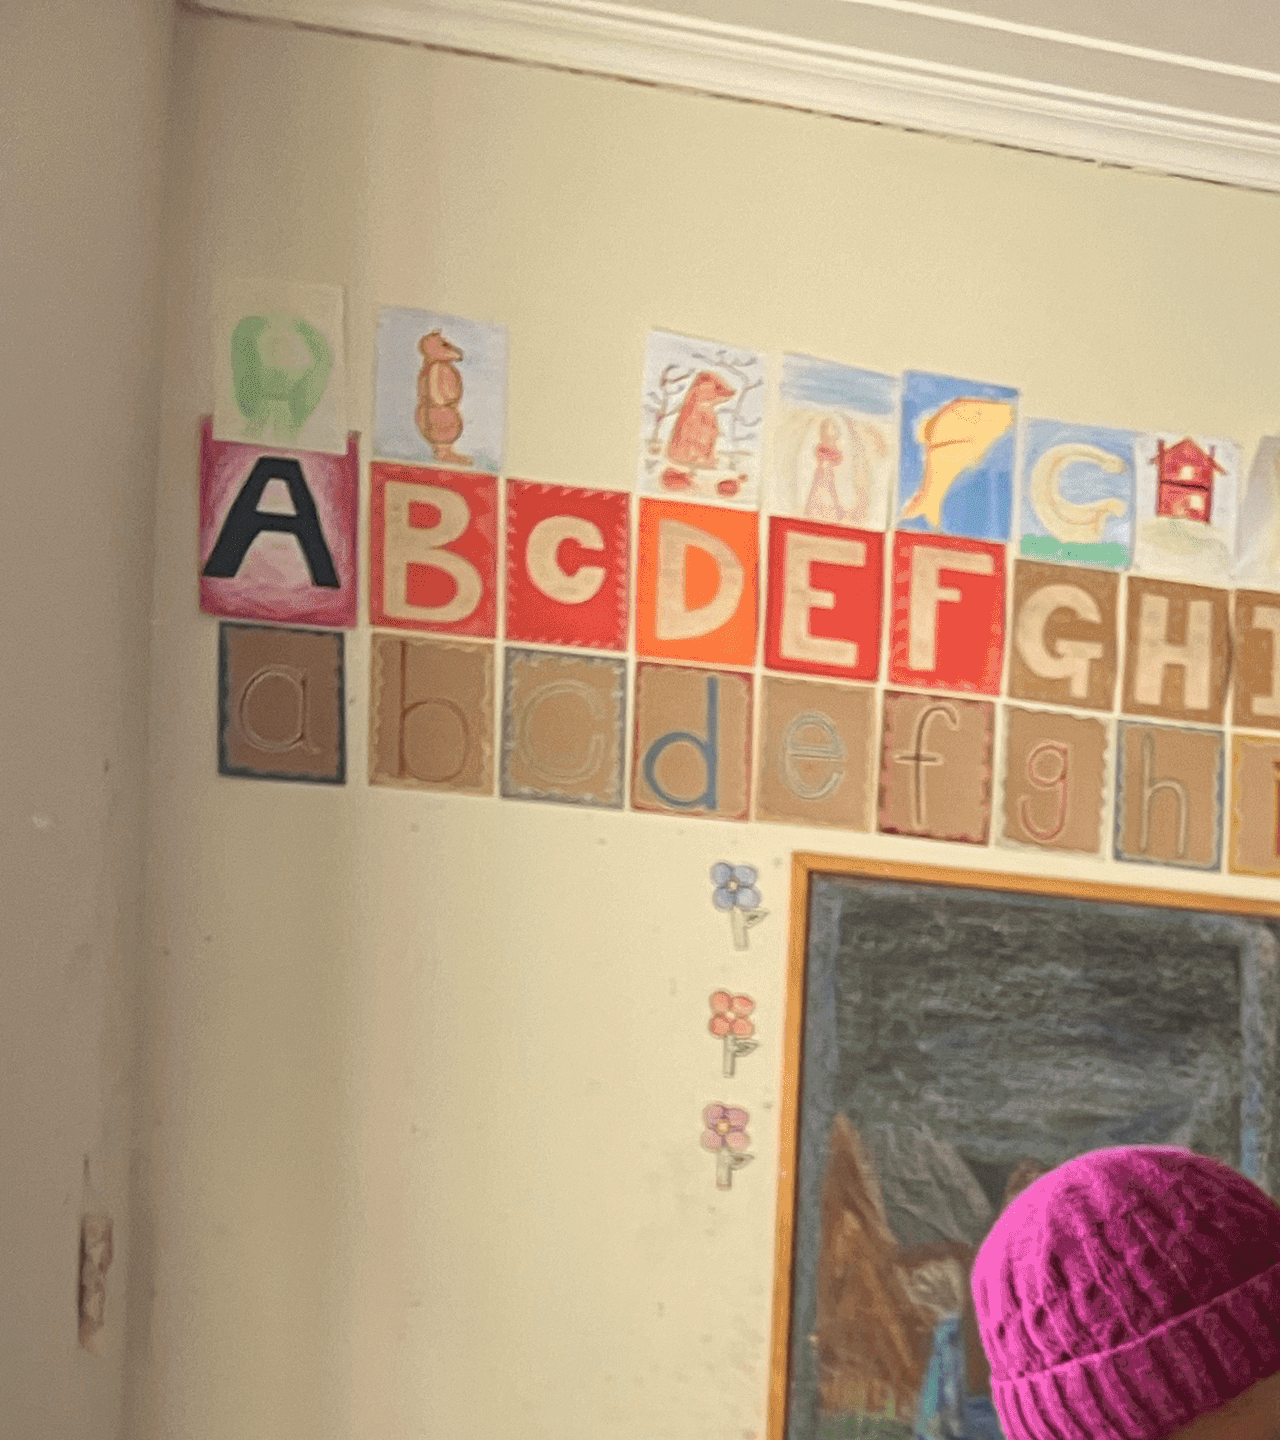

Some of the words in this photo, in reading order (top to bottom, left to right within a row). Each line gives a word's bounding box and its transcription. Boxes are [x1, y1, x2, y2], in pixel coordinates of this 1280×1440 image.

[204, 457, 340, 588] A
[382, 483, 483, 623] B
[656, 518, 744, 640] D
[779, 531, 867, 667] E
[908, 545, 994, 670] F
[1016, 585, 1103, 699] G
[1133, 593, 1211, 711] H
[239, 663, 320, 755] a
[399, 642, 471, 782] b
[644, 676, 718, 810] d
[784, 711, 844, 798] e
[896, 704, 960, 825] f
[1017, 741, 1070, 841] g
[1140, 739, 1189, 856] h
